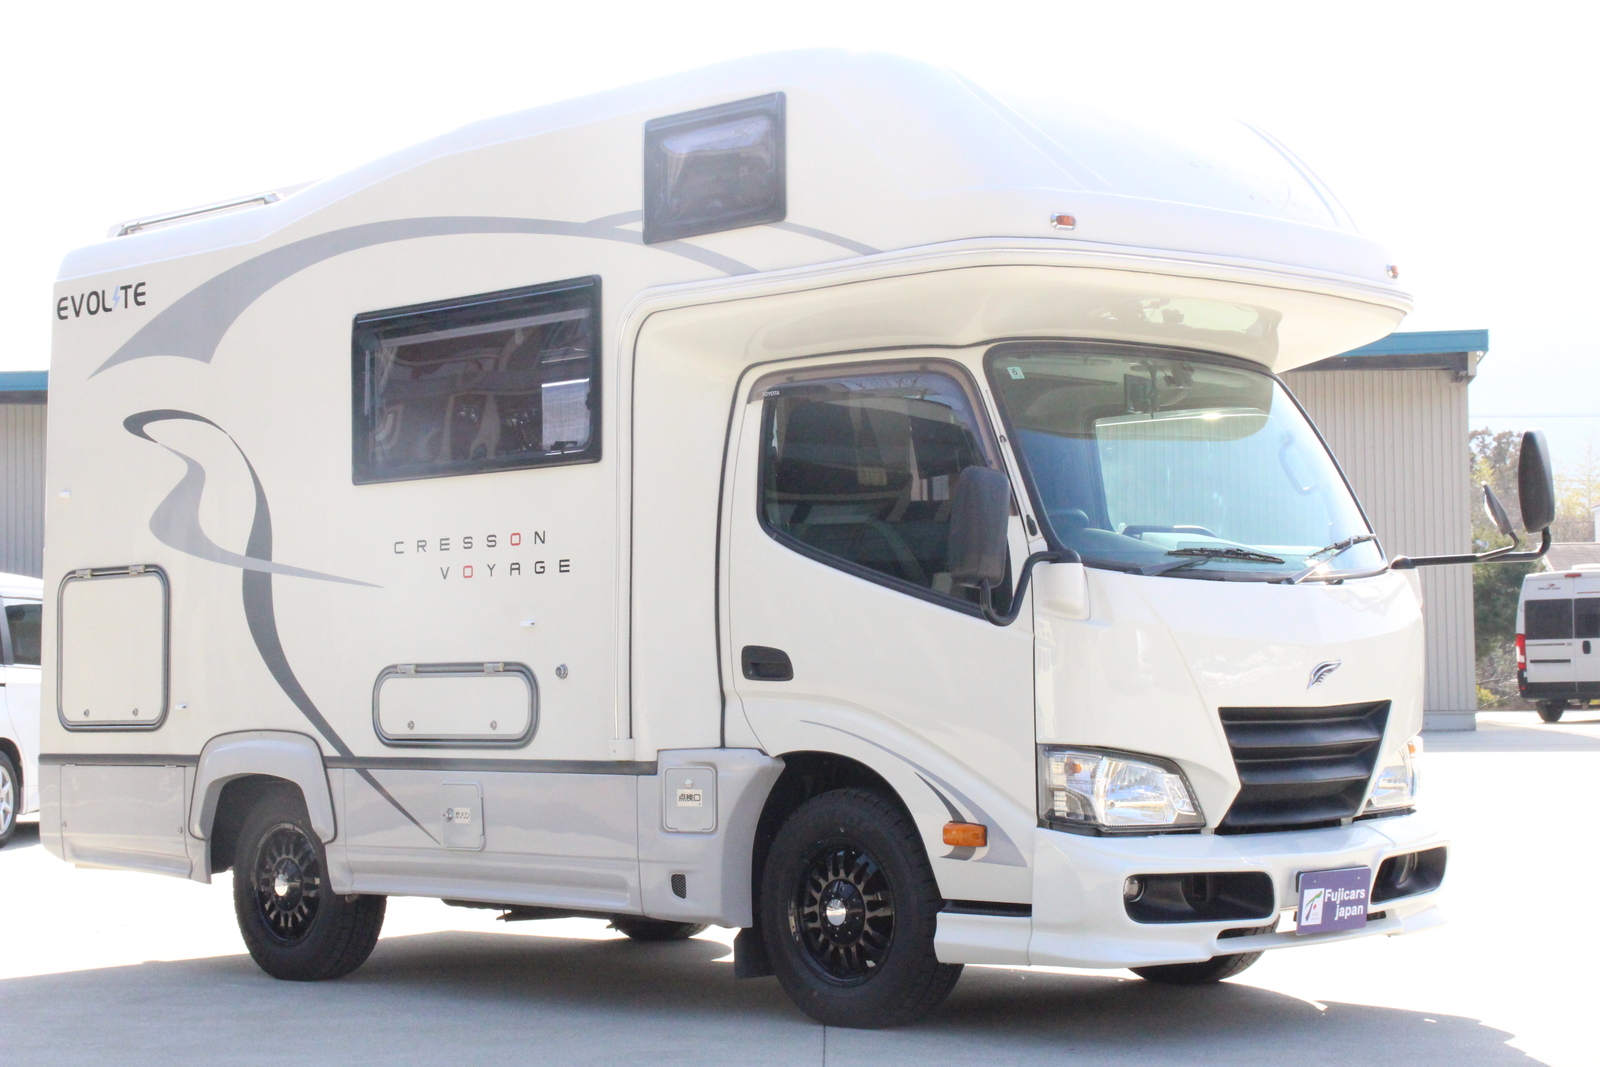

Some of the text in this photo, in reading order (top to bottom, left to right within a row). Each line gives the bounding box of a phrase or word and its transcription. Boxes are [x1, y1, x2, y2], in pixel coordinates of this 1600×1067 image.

[394, 531, 546, 554] CRESSON
[440, 559, 571, 580] VOYAGE
[679, 793, 701, 802] 点検口
[1324, 888, 1366, 904] Fujicars
[1334, 904, 1364, 921] japan
